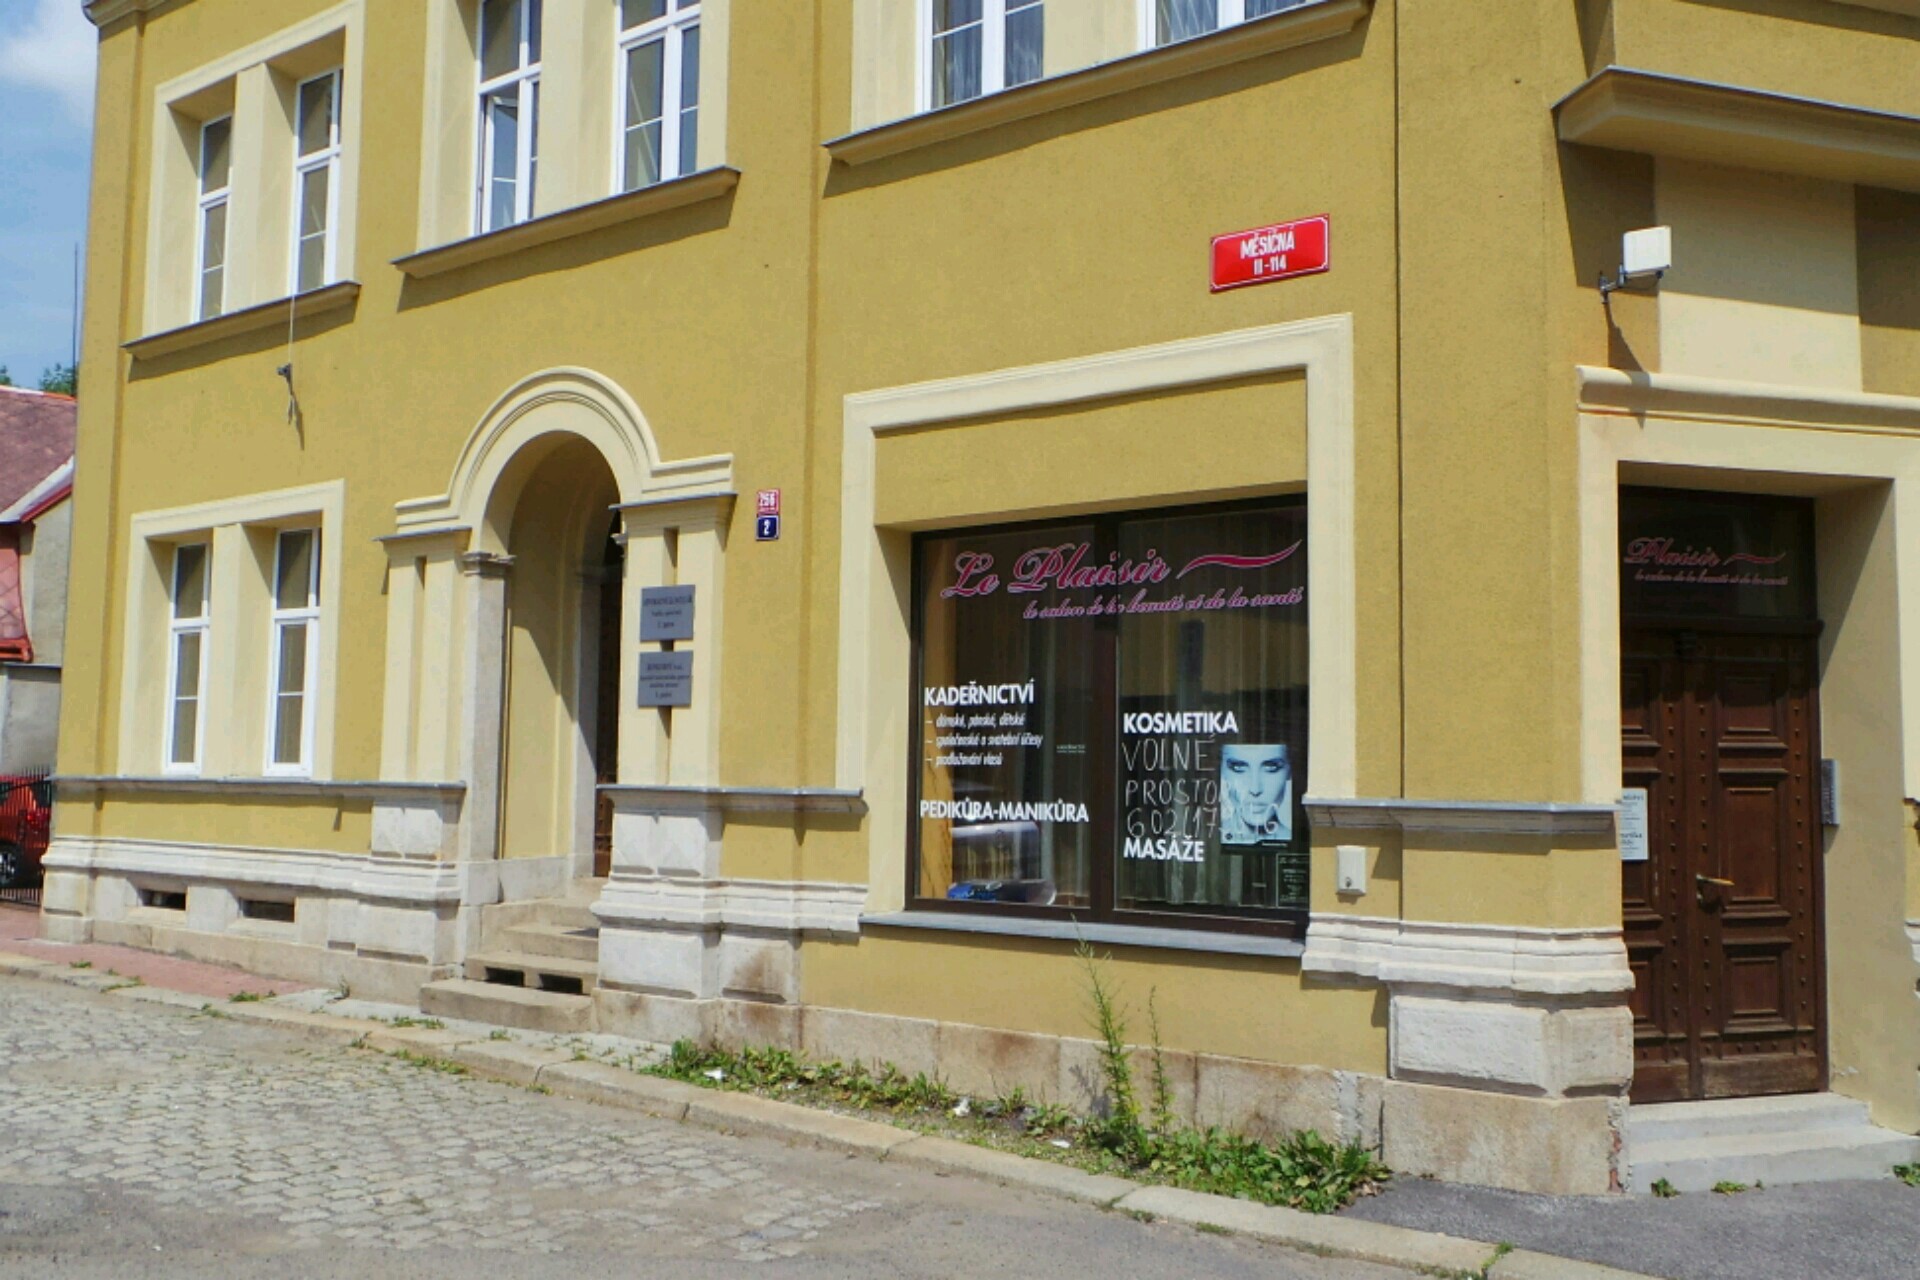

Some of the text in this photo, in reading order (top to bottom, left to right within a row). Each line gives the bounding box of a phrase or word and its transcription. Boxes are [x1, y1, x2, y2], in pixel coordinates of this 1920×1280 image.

[764, 519, 771, 536] 2
[1624, 537, 1721, 567] Plaisir
[940, 542, 1172, 598] Le Plaisir
[924, 678, 1035, 706] KADEŘNICTVÍ
[1123, 711, 1239, 734] KOSMETIKA
[1121, 732, 1217, 772] VOLNÉ
[1123, 834, 1205, 862] MASÁŽE
